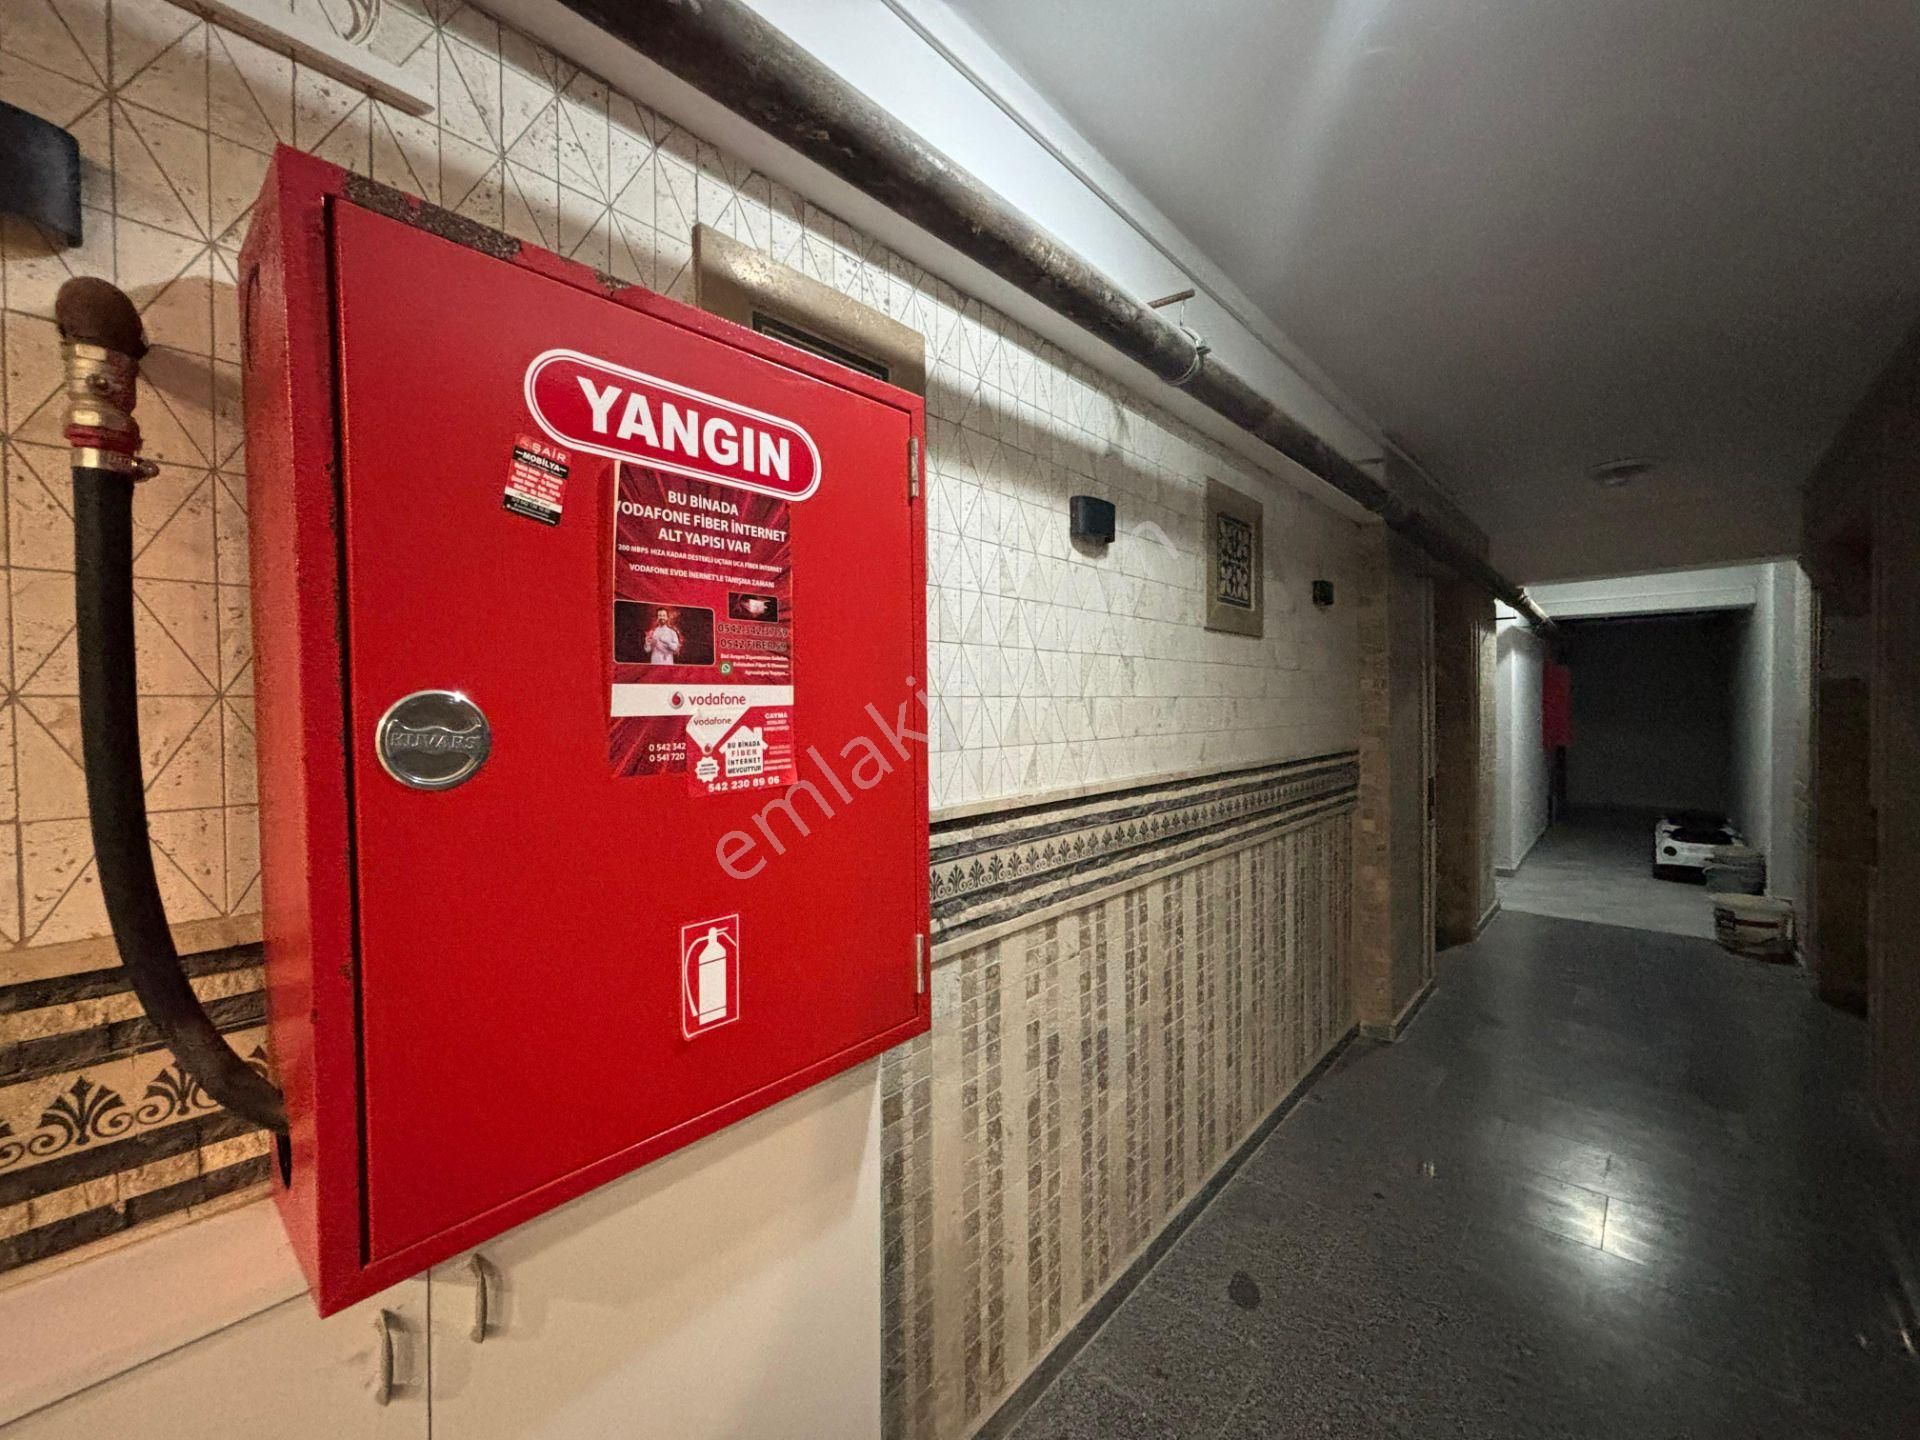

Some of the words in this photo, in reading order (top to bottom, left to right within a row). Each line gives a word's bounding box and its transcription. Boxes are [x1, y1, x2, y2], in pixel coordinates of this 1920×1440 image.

[576, 375, 790, 482] YANGIN
[522, 451, 561, 472] MOBİLYA
[668, 490, 687, 506] BU
[690, 494, 739, 516] BİNADA
[693, 512, 729, 532] FİBER
[731, 518, 787, 543] İNTERNET
[658, 527, 683, 543] ALT
[685, 531, 725, 550] YAPISI
[726, 538, 752, 554] VAR
[629, 563, 669, 576] VODAFONE
[669, 568, 688, 578] EVDE
[689, 692, 746, 706] vodafone
[693, 717, 732, 726] vodafone
[708, 782, 728, 793] 542
